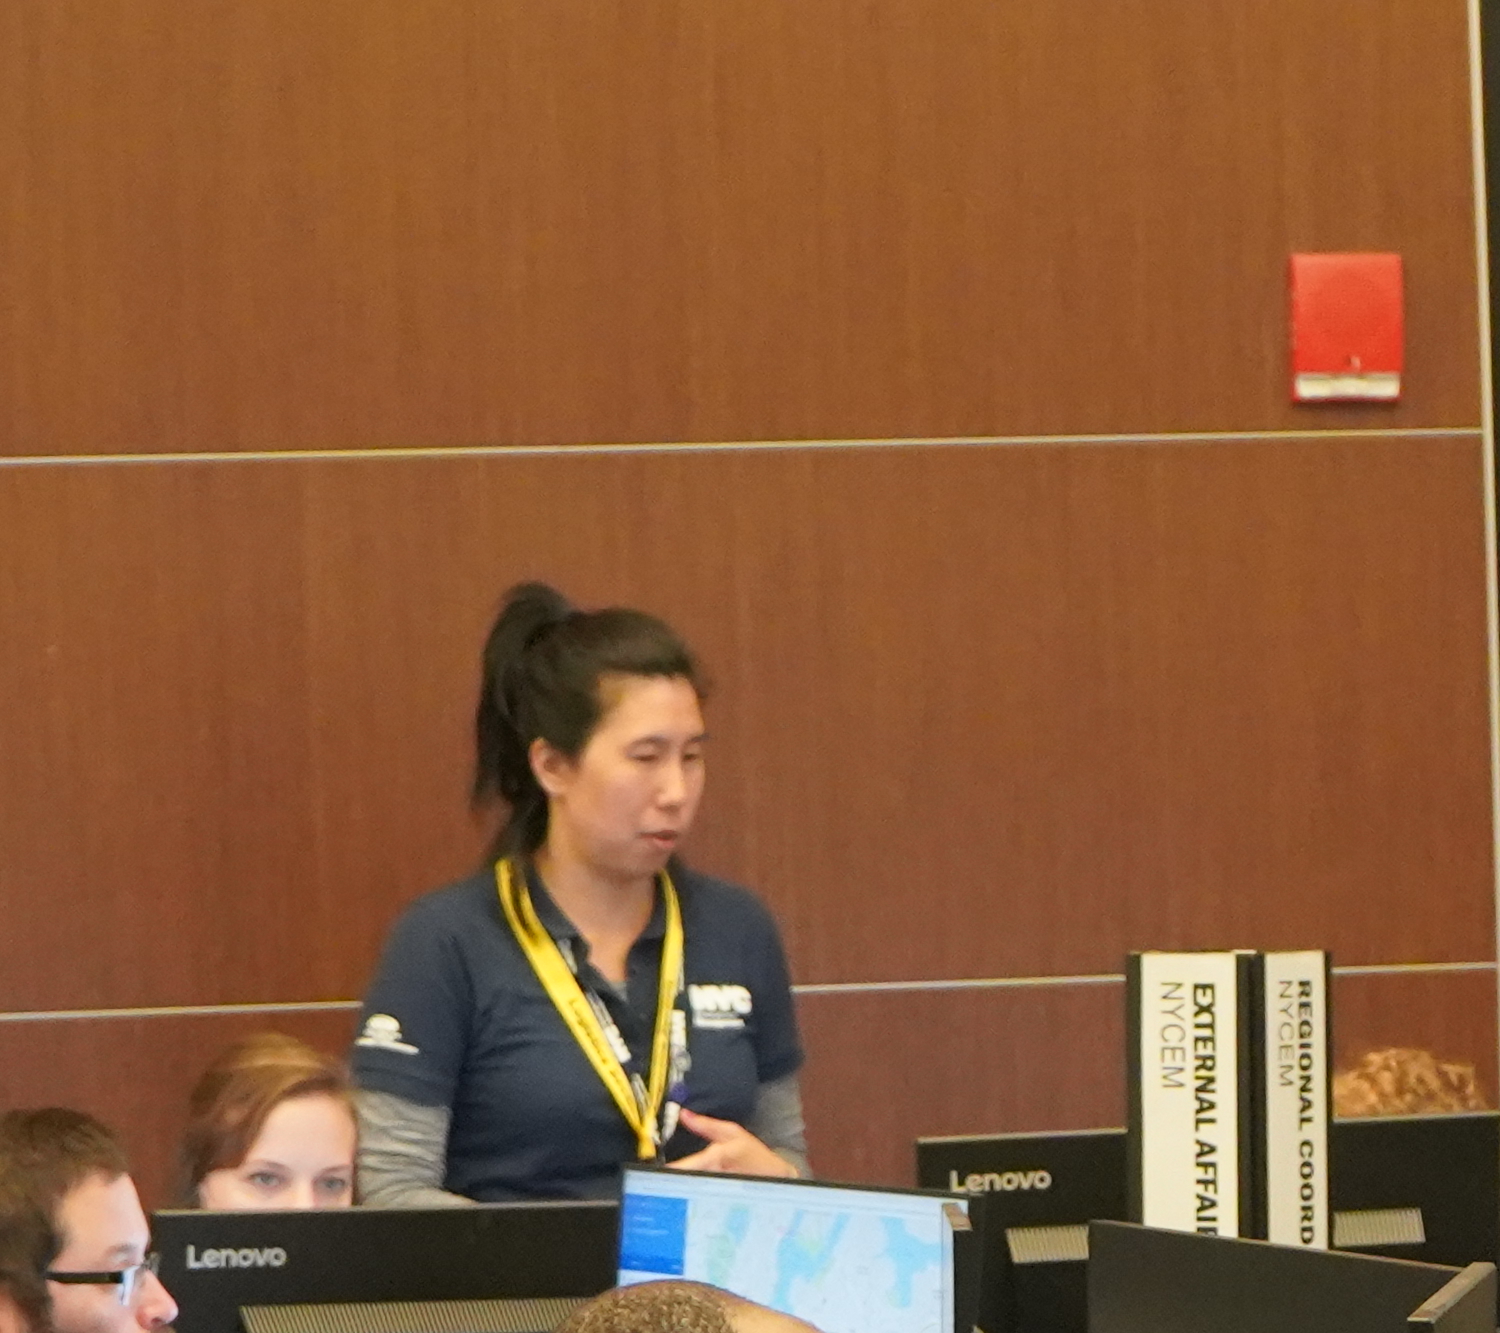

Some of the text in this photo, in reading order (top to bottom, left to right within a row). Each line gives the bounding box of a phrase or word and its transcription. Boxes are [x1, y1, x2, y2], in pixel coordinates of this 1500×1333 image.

[1160, 981, 1186, 1089] NYCEM
[1193, 982, 1217, 1131] EXTERNAL
[1278, 979, 1295, 1087] NYCEM
[1298, 979, 1315, 1245] REGIONAL COORD
[949, 1169, 1052, 1194] Lenovo
[185, 1244, 288, 1270] Lenovo
